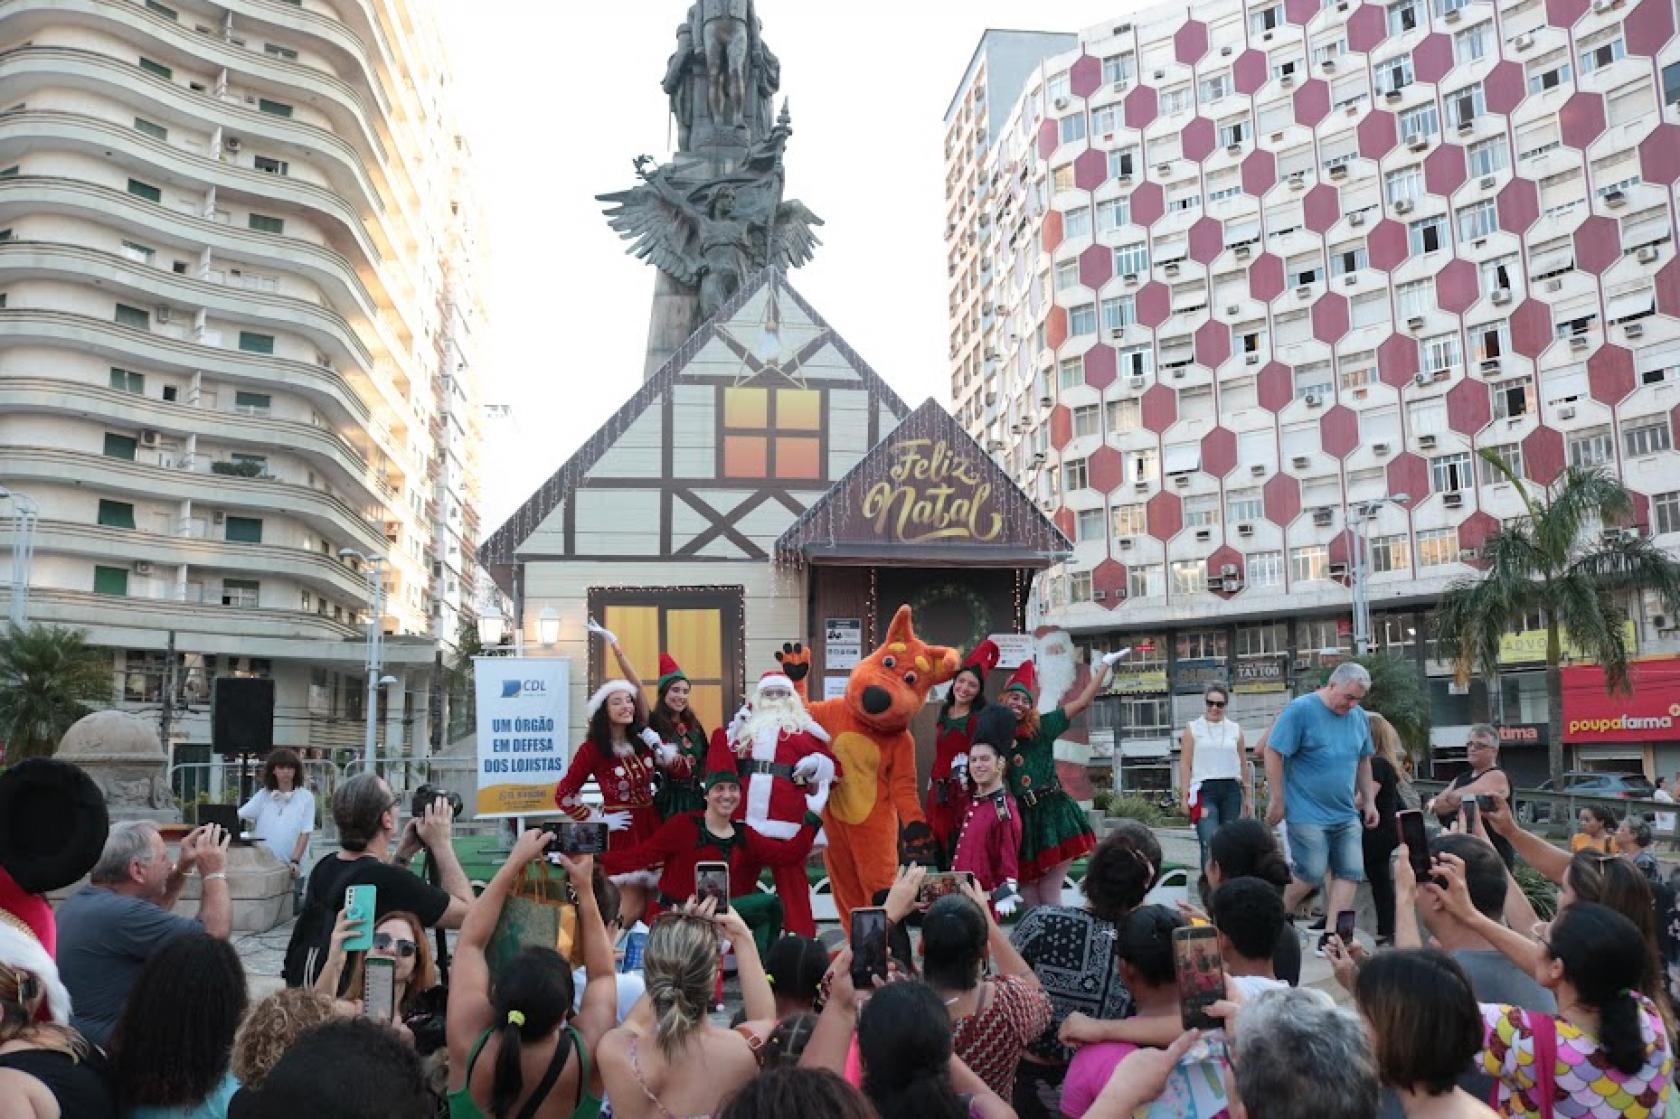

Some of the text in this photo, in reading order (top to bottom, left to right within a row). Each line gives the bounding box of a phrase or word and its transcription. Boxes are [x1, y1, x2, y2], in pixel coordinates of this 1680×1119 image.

[890, 438, 980, 486] Feliz
[862, 482, 1003, 543] Natal
[1238, 666, 1281, 679] TATTOO
[492, 715, 554, 733] UM ÓRGÃO
[1569, 713, 1673, 736] poupafarma
[1499, 725, 1538, 741] tima
[493, 737, 554, 753] EM DEFESA
[484, 756, 562, 773] DOS LOJISTAS
